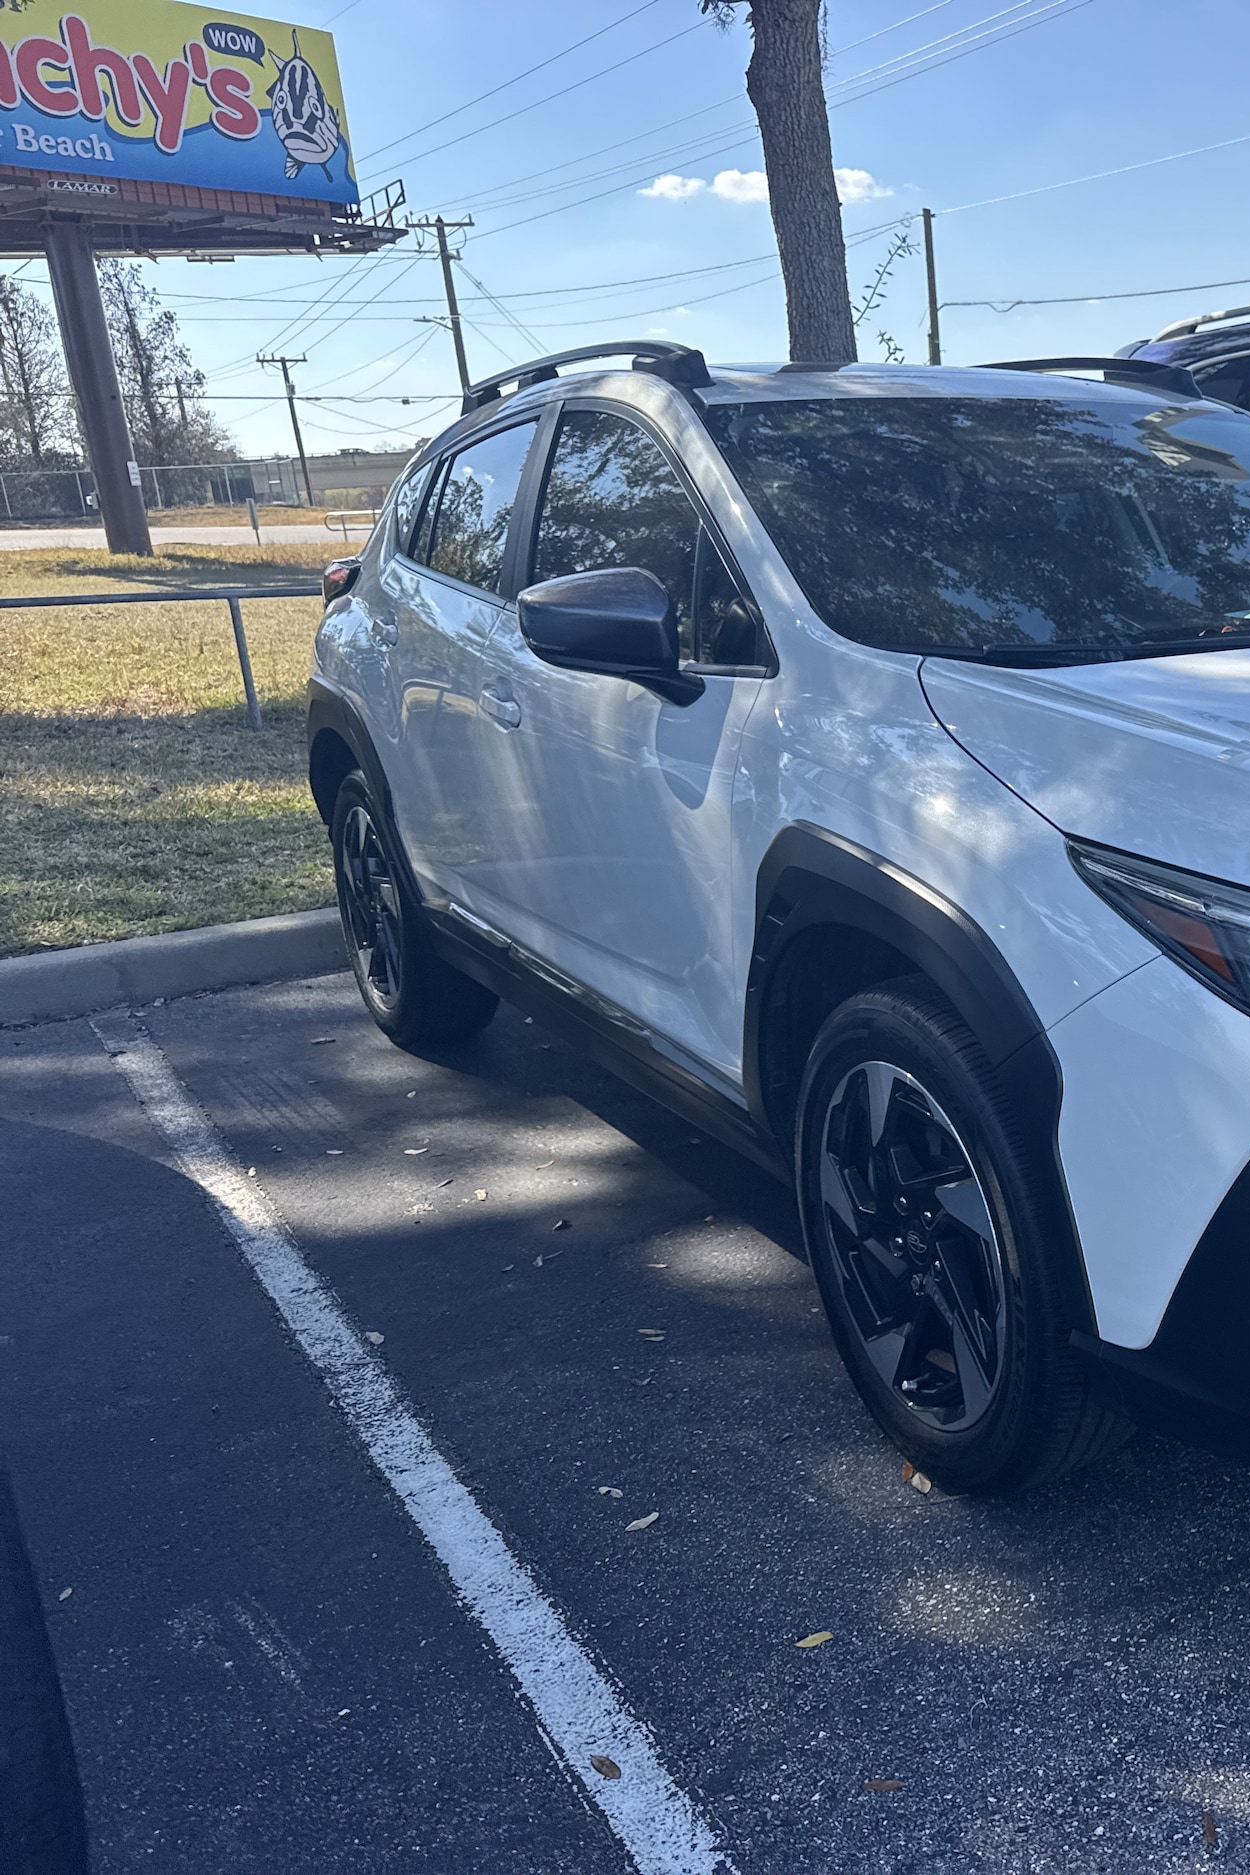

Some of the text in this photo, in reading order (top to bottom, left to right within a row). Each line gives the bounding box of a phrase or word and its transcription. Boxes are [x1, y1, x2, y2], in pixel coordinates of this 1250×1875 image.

[208, 27, 256, 54] WOW
[11, 123, 115, 162] Beach
[54, 180, 111, 193] LAMAR
